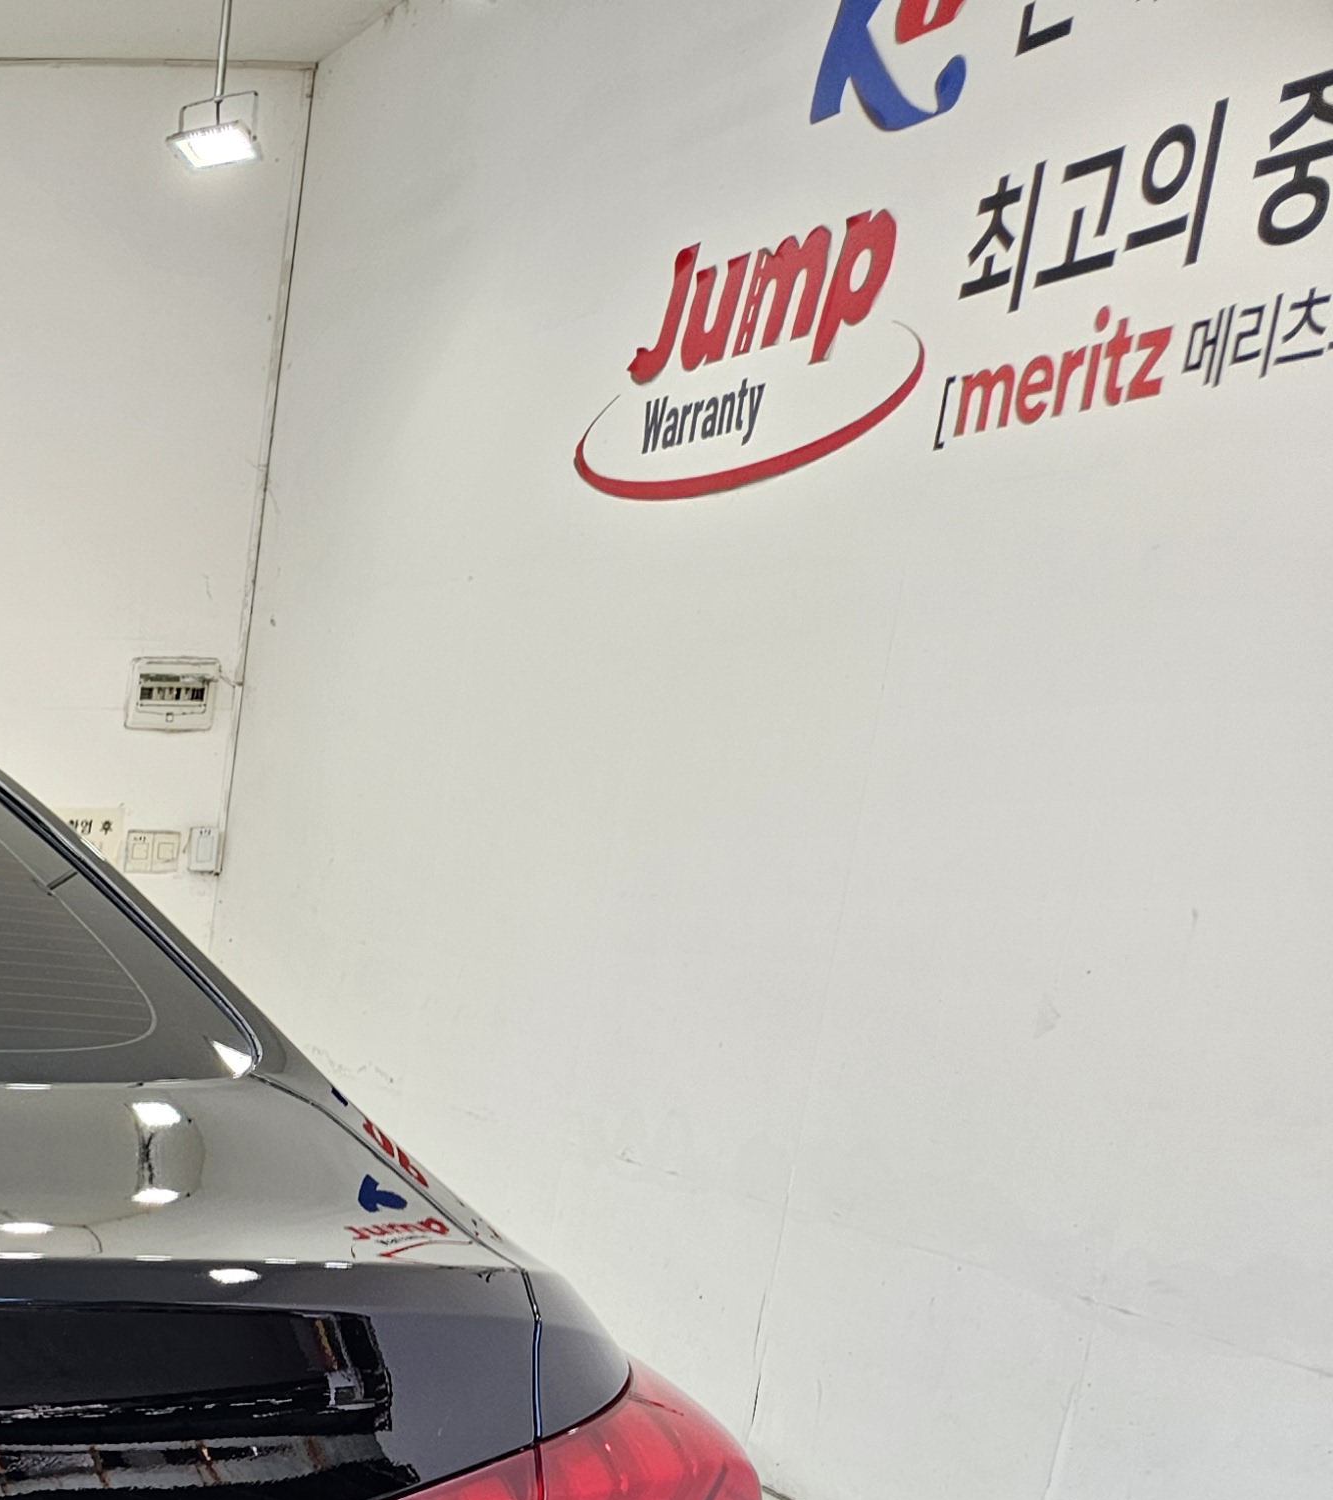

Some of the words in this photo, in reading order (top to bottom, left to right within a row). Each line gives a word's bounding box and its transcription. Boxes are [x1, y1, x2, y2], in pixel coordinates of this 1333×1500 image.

[958, 96, 1230, 314] 최고의
[627, 208, 898, 384] Jump
[1181, 287, 1333, 388] 메리츠
[640, 377, 766, 455] Warranty
